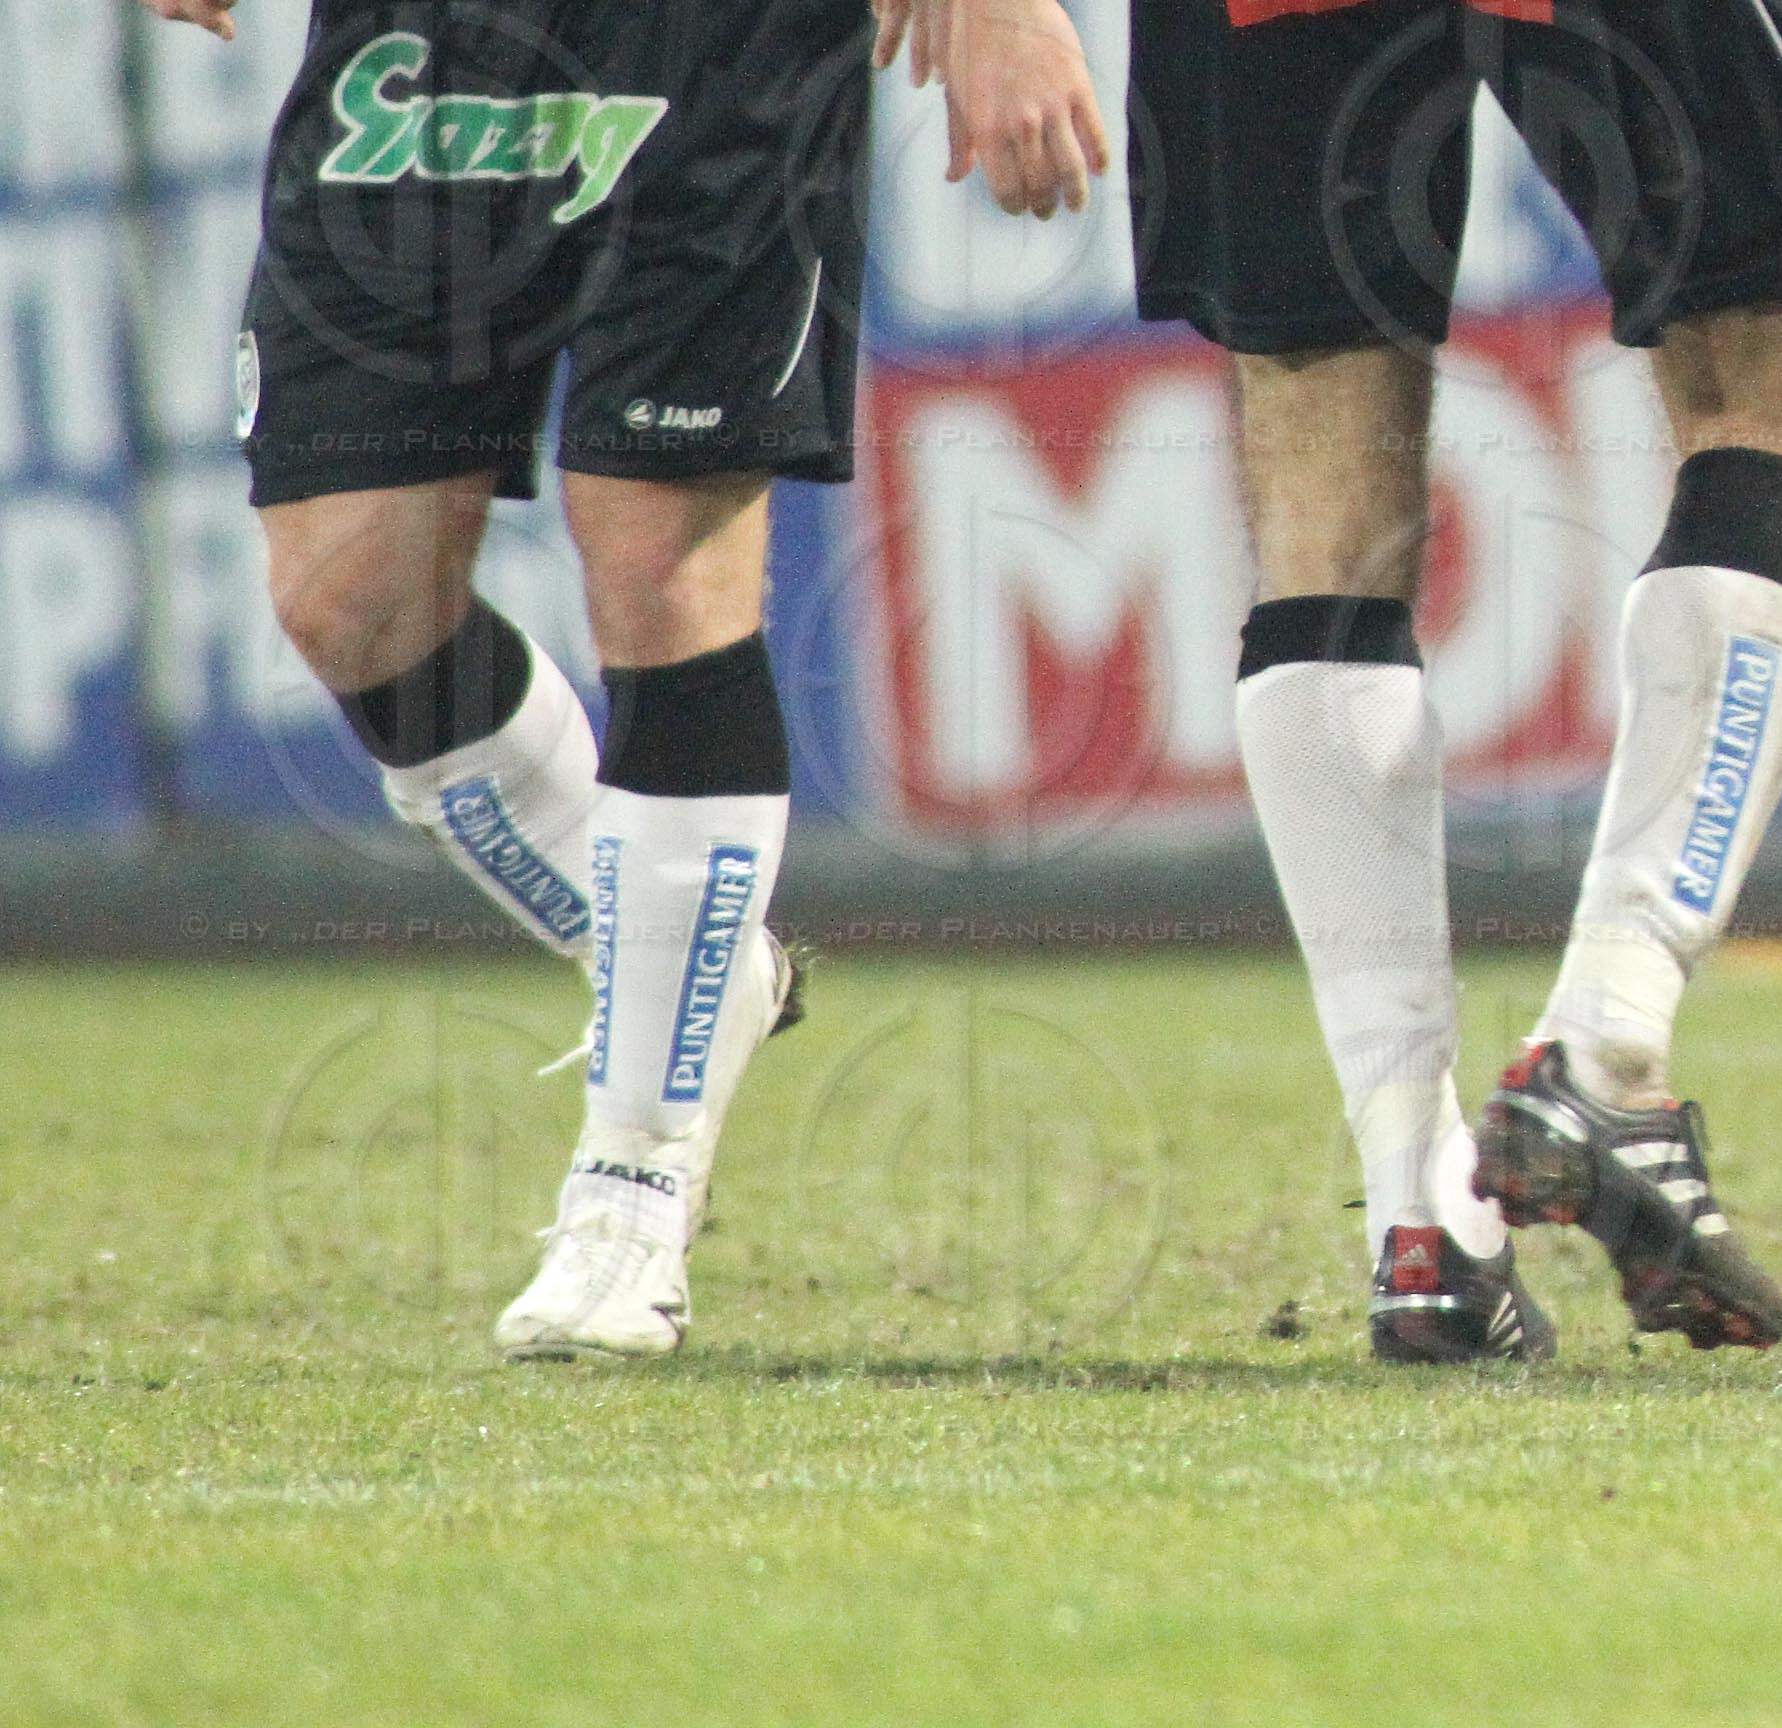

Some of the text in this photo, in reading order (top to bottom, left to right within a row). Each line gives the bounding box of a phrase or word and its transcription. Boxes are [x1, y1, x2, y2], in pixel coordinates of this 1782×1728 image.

[658, 406, 723, 430] JAKO
[1680, 651, 1773, 899] PUNTIGAMER
[670, 856, 756, 1092] PUNTIGAMER
[585, 1159, 676, 1197] JAKO
